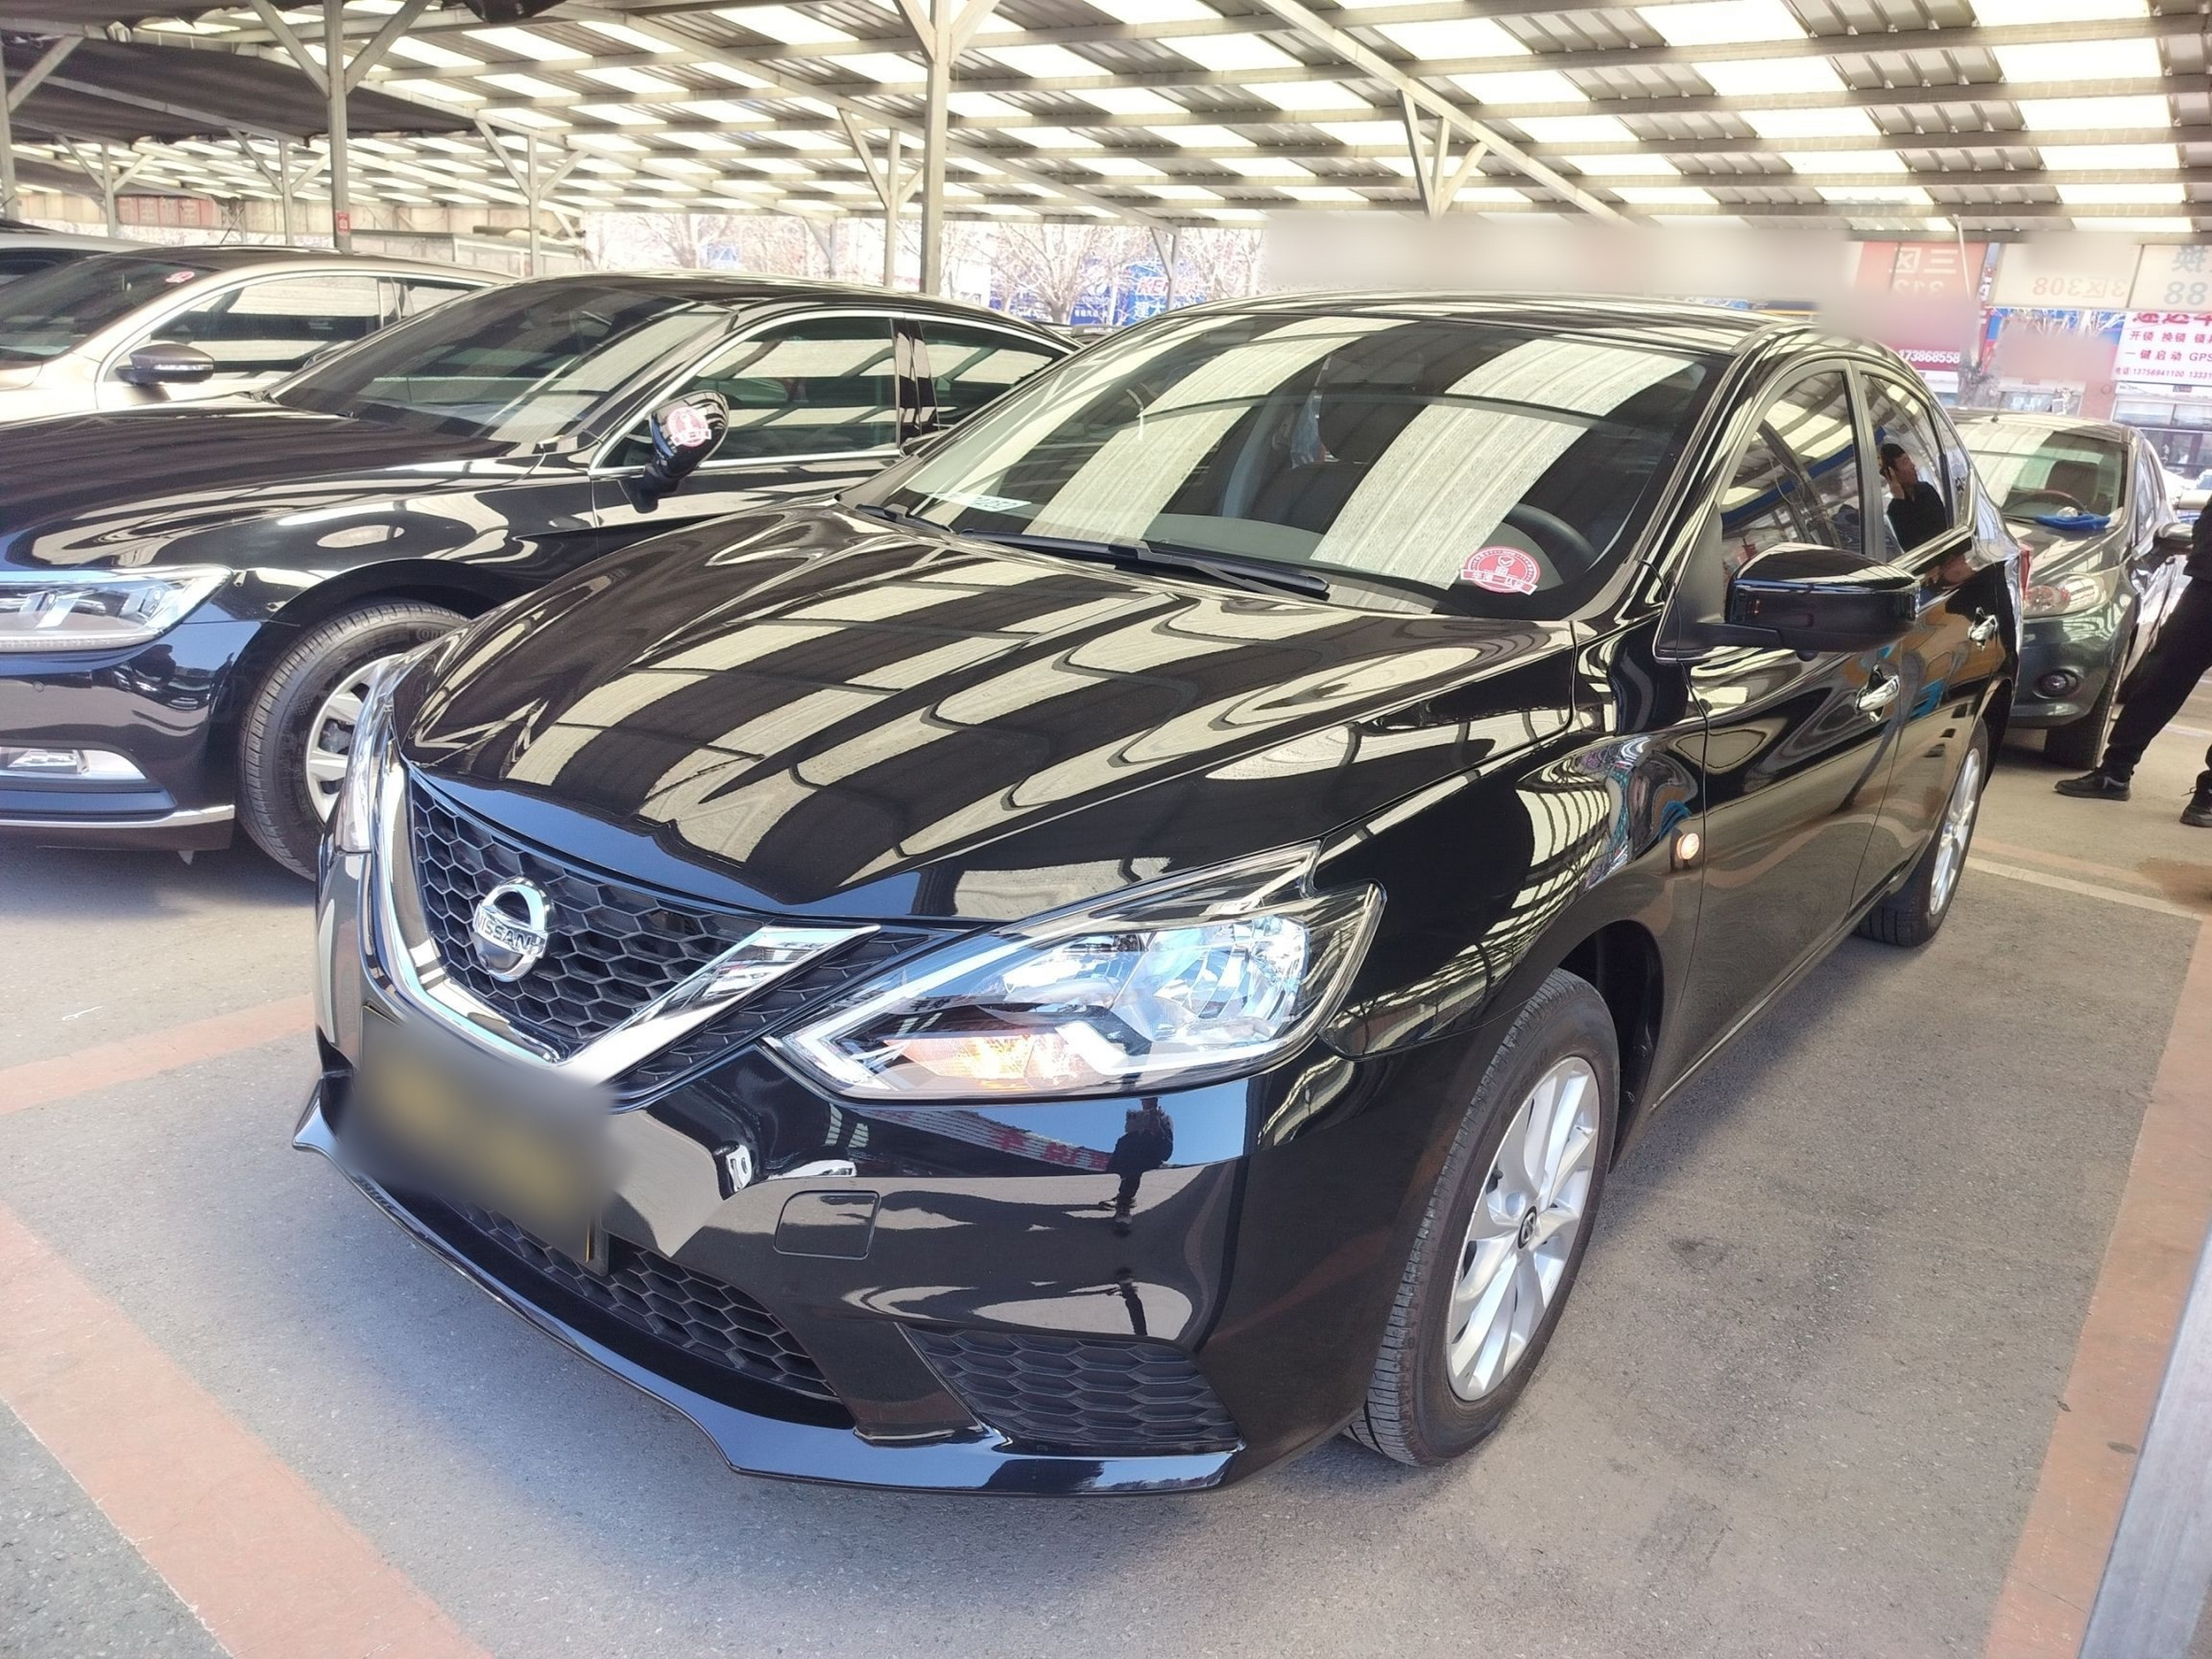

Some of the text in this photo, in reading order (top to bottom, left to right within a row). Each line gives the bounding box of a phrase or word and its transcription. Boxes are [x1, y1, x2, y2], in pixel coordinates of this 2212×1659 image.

[2130, 331, 2153, 341] 开锁
[2162, 332, 2186, 343] 换锁
[2125, 349, 2212, 362] 一键启动 GPS
[475, 912, 532, 951] NISSAN
